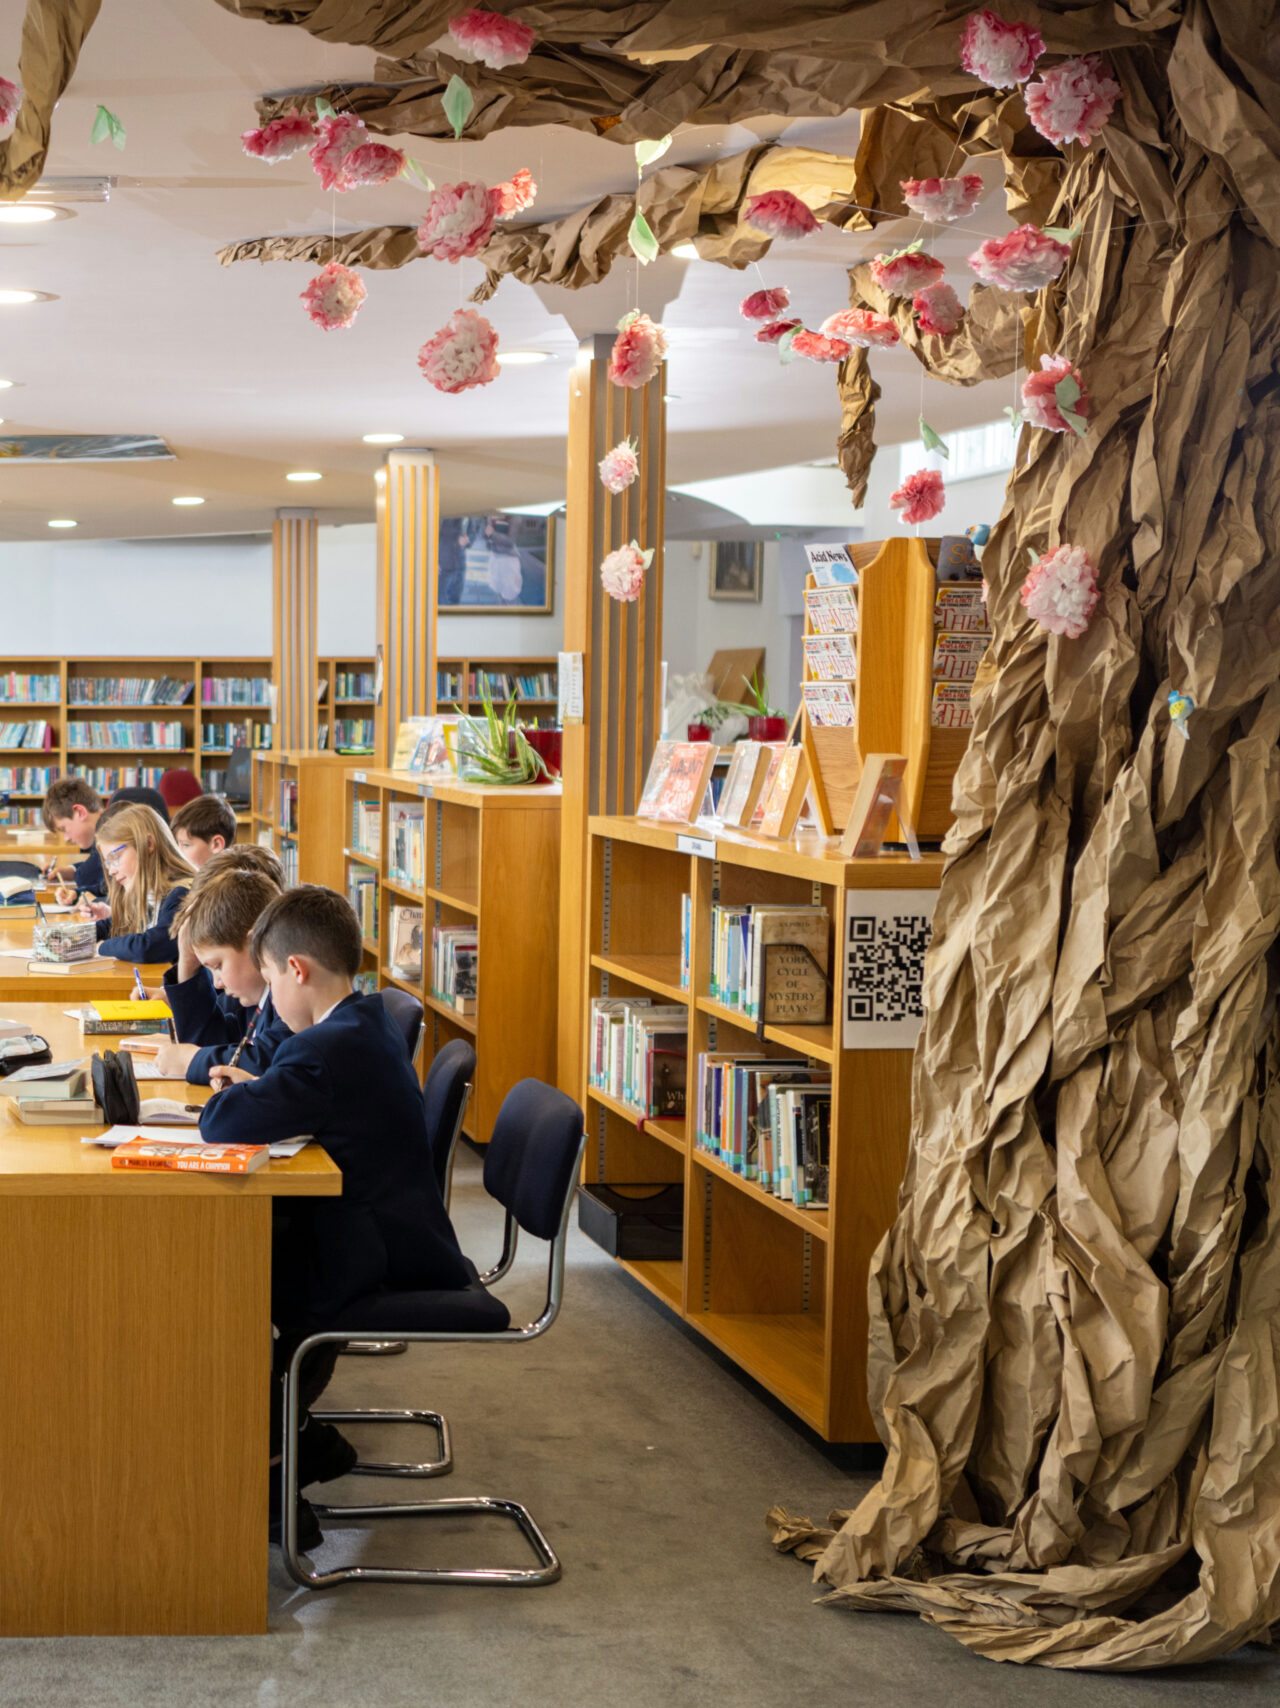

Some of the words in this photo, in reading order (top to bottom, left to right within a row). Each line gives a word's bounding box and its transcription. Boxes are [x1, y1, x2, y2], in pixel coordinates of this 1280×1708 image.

[811, 551, 828, 563] Acid
[825, 550, 848, 562] News
[942, 608, 979, 630] THE
[937, 654, 978, 678] THE
[936, 703, 974, 727] THE
[779, 955, 809, 964] YORK
[776, 967, 808, 976] CYCLE
[786, 980, 798, 988] OF
[768, 992, 815, 1001] MYSTERY
[776, 1004, 808, 1013] PLAYS
[177, 1161, 190, 1169] YOU
